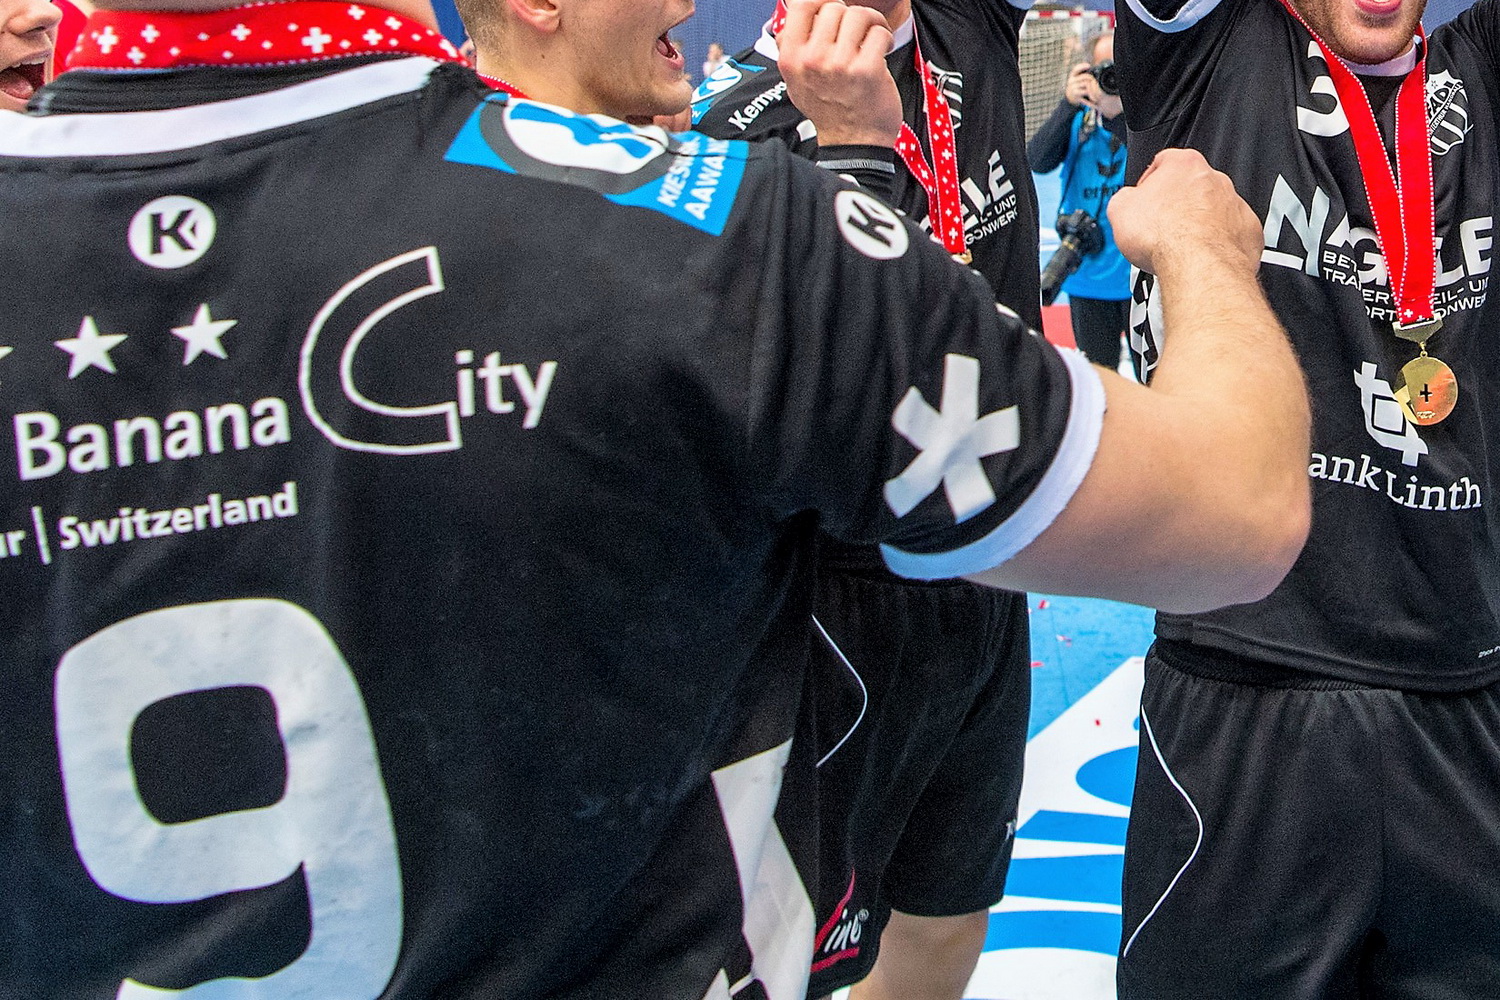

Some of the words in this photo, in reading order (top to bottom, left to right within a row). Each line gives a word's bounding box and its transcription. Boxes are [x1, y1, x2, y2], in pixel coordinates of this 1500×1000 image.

[13, 396, 292, 482] Banana
[298, 245, 558, 456] City
[58, 481, 299, 551] Switzerland
[1307, 451, 1381, 493] ank
[1385, 469, 1483, 512] Linth
[53, 597, 404, 1000] 9
